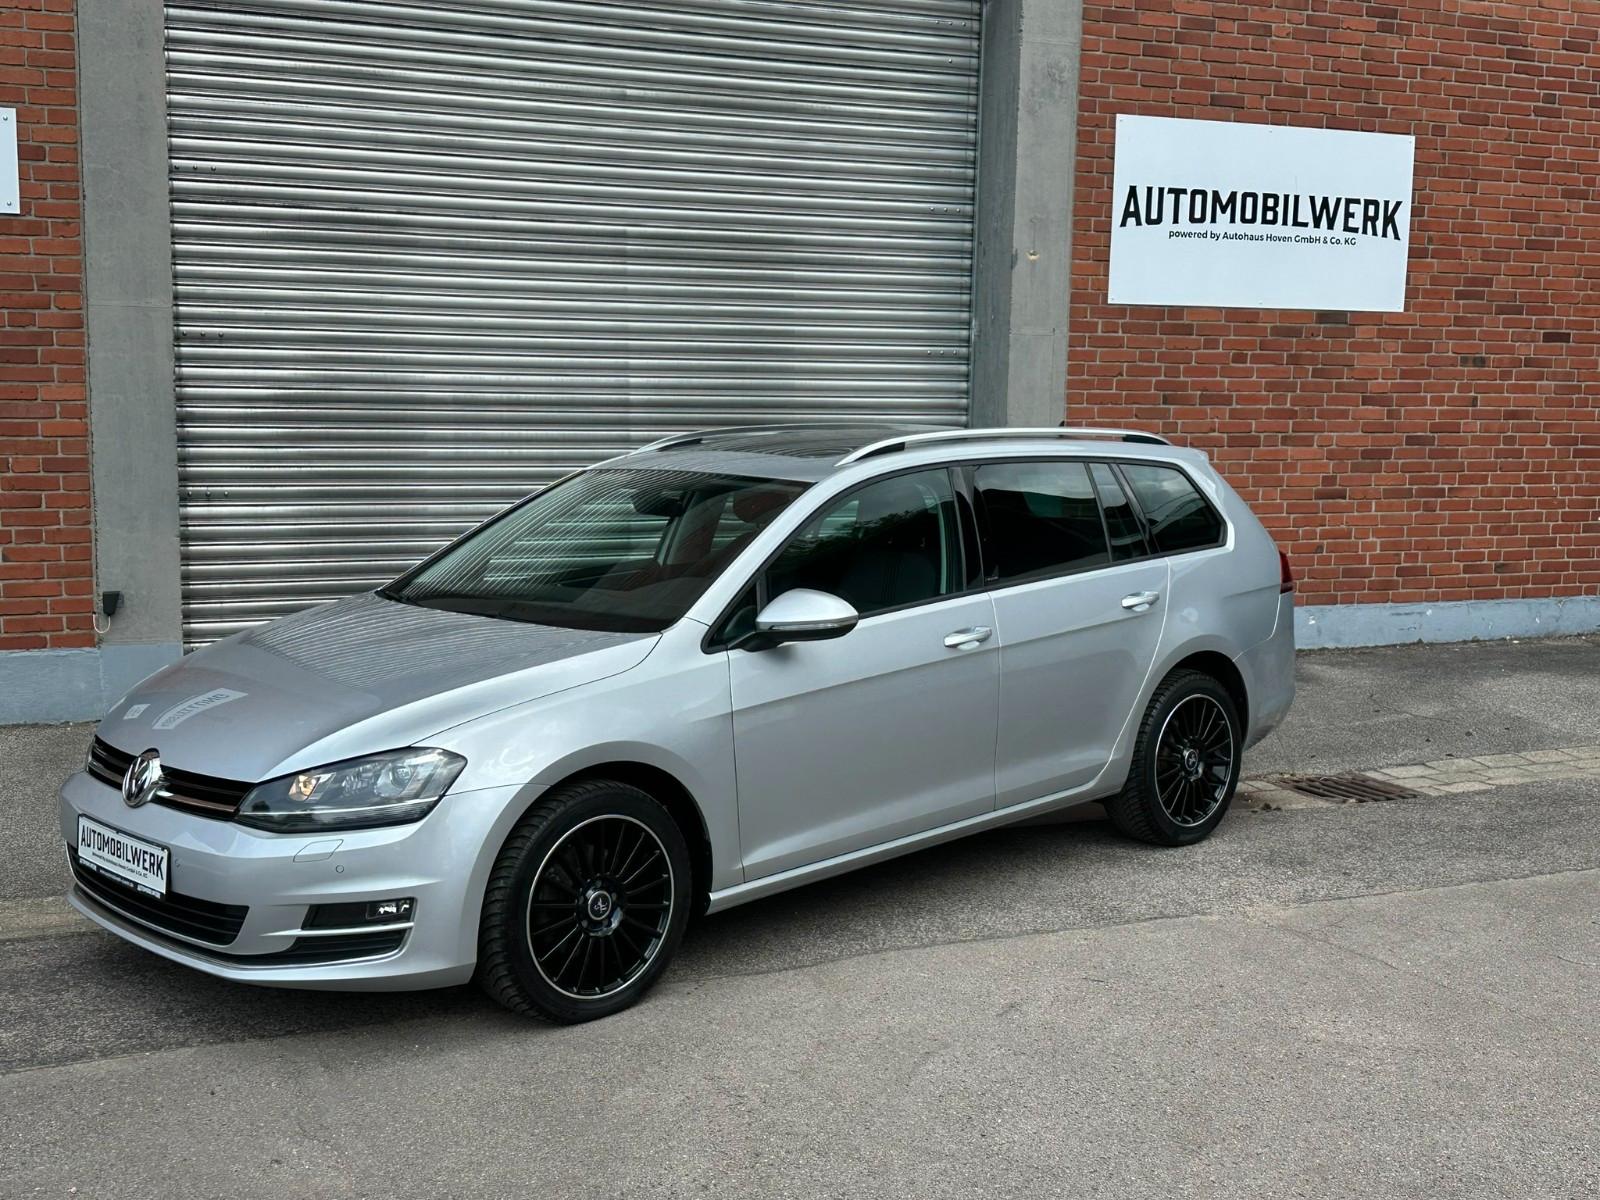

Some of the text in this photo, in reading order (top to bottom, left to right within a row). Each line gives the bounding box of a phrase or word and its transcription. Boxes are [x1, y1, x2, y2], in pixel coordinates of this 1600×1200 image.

[1119, 185, 1403, 241] AUTOMOBILWERK
[1168, 229, 1357, 246] powered by Autohaus Hoven GmbH & Co. KG
[80, 825, 164, 880] AUTOMOBILWERK
